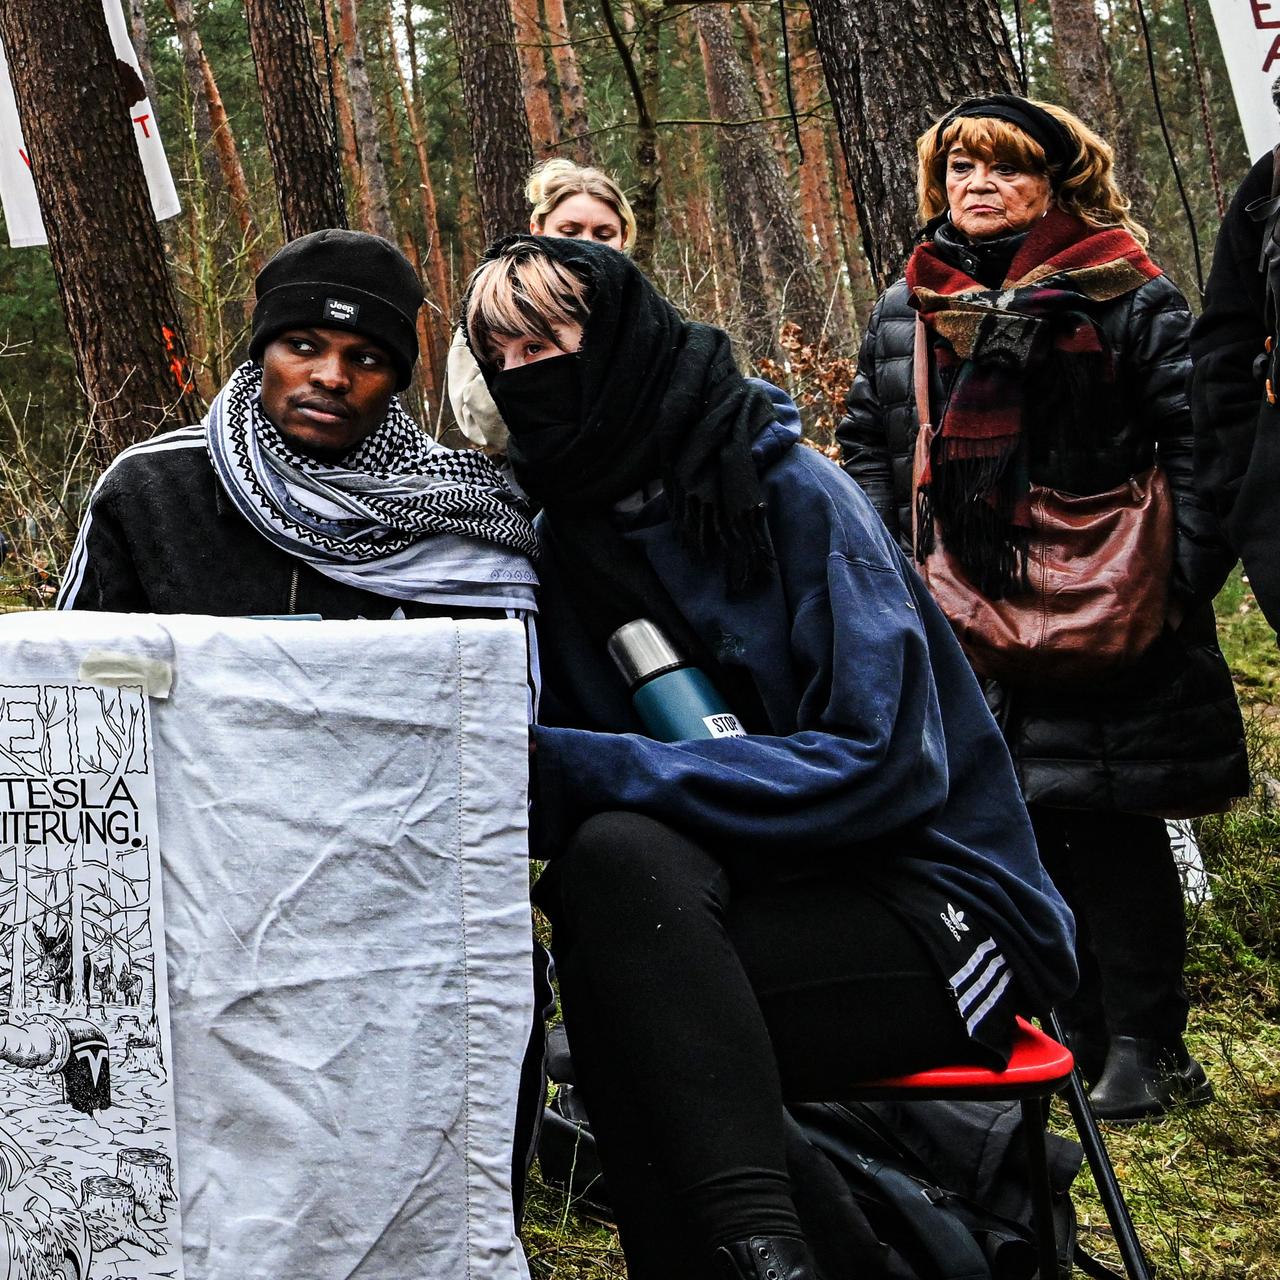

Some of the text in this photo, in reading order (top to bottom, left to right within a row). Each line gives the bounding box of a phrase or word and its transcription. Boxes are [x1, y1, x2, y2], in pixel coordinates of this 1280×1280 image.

[330, 301, 354, 314] Jeep
[712, 716, 738, 733] STOP
[940, 912, 961, 942] adidas
